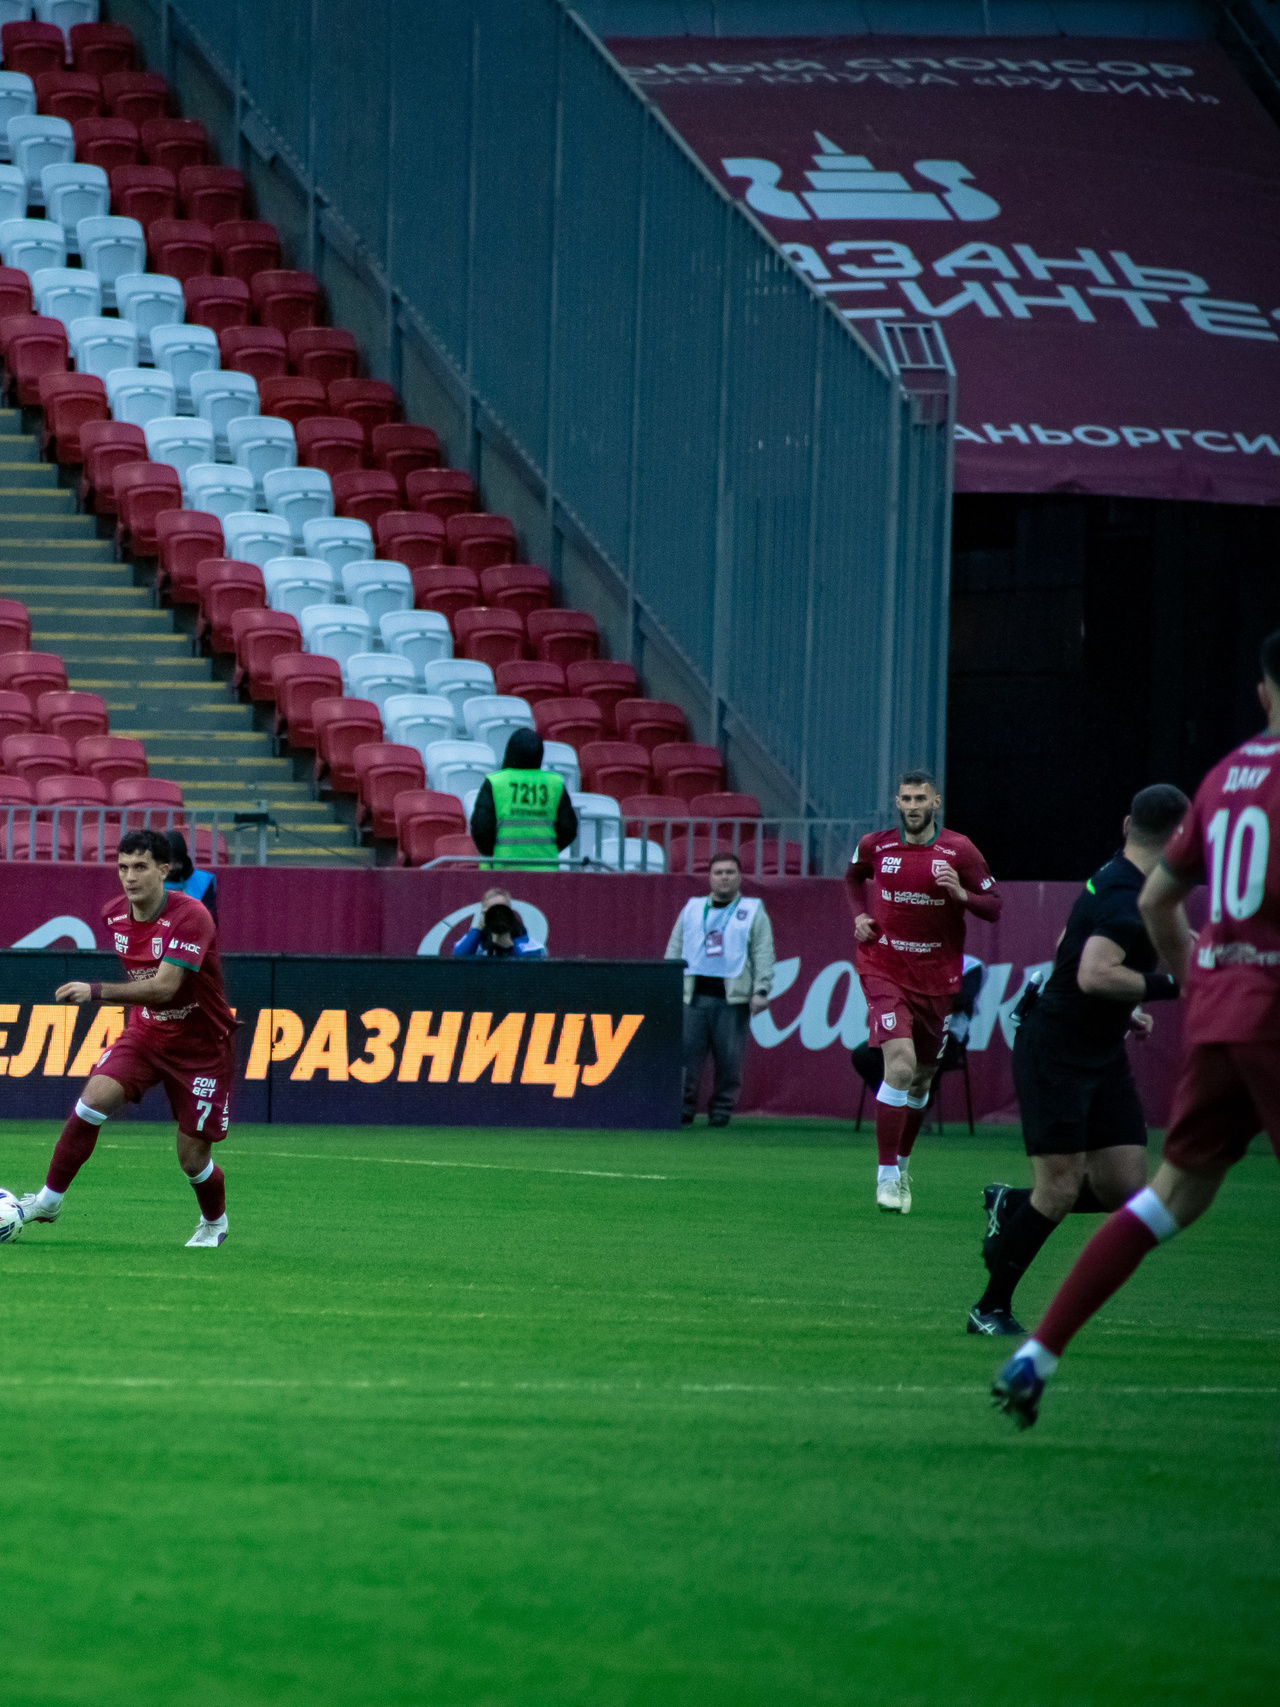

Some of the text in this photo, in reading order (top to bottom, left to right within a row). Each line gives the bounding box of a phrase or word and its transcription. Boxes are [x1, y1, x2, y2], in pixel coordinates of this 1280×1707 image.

[845, 56, 1195, 80] СПОНСОР
[1222, 766, 1271, 793] ДАКУ
[509, 782, 548, 807] 7213
[881, 856, 902, 866] FON
[881, 865, 901, 874] BET
[1207, 806, 1270, 924] 10
[114, 932, 129, 945] FON
[244, 1007, 645, 1099] РАЗНИЦУ
[191, 1086, 216, 1098] BET
[192, 1076, 217, 1088] FON
[196, 1100, 212, 1131] 7
